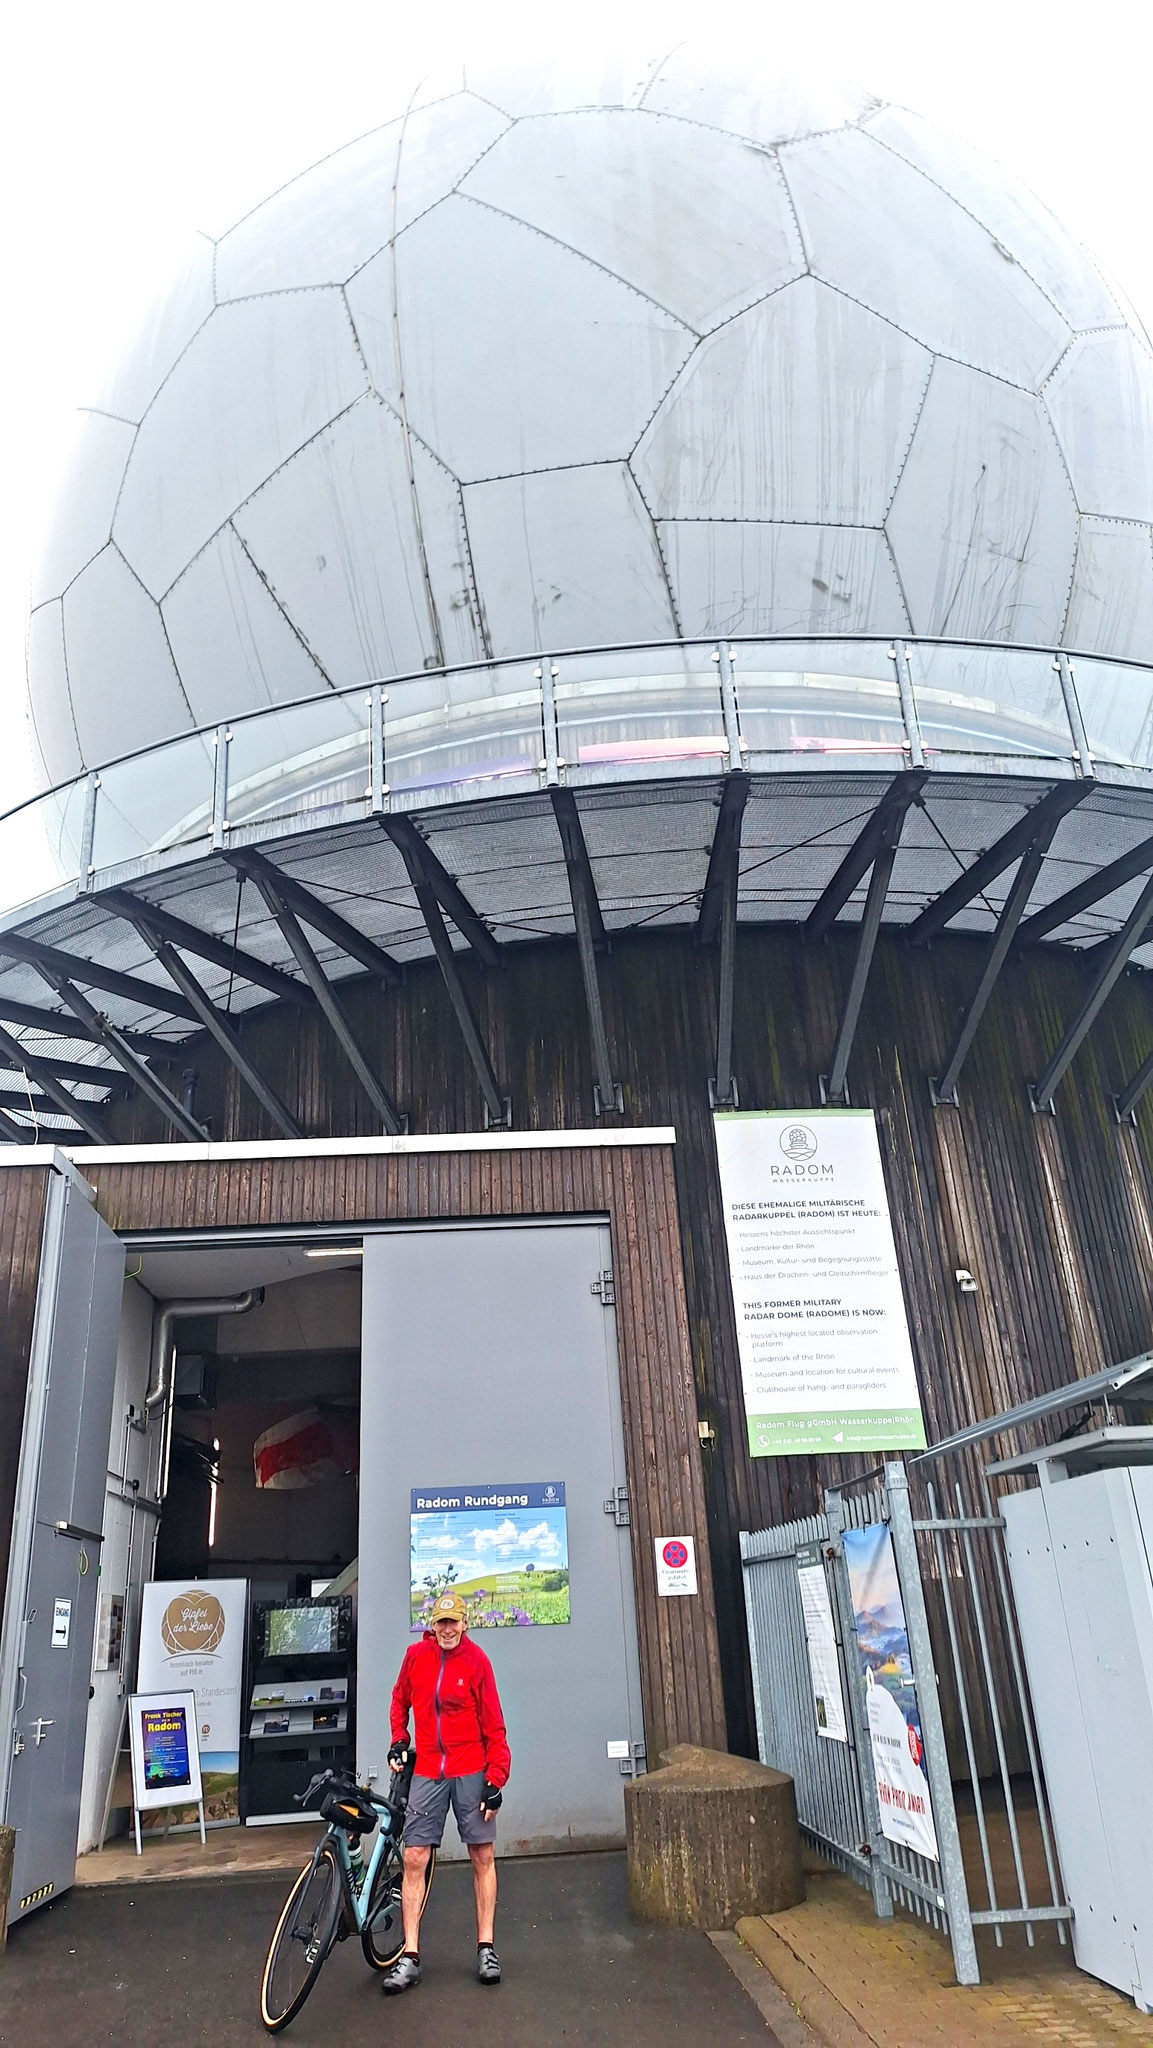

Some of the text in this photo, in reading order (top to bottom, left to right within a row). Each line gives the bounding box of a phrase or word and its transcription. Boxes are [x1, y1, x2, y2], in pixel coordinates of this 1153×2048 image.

[771, 1164, 834, 1176] RADOM
[758, 1201, 807, 1209] EHEMALIGE
[809, 1199, 865, 1207] MILITÄRISCHE
[733, 1211, 795, 1221] RADARKUPPEL
[798, 1210, 835, 1218] (RADOM)
[743, 1298, 842, 1309] THIS FORMER MILITARY
[744, 1312, 775, 1320] RADAR
[777, 1311, 804, 1319] DOME
[806, 1309, 850, 1318] (RADOME)
[780, 1330, 807, 1339] highest
[752, 1340, 783, 1349] platform
[753, 1355, 791, 1363] Landmark
[807, 1384, 829, 1392] hang-
[846, 1382, 887, 1390] paragliders
[756, 1420, 785, 1429] Radom
[787, 1420, 805, 1429] Flug
[807, 1418, 837, 1428] gGmbH
[416, 1494, 528, 1509] Radom Rundgang
[181, 1608, 207, 1621] Gipfel
[173, 1621, 214, 1633] der Liebe
[201, 1686, 237, 1697] Standesamt
[147, 1722, 181, 1732] Radom
